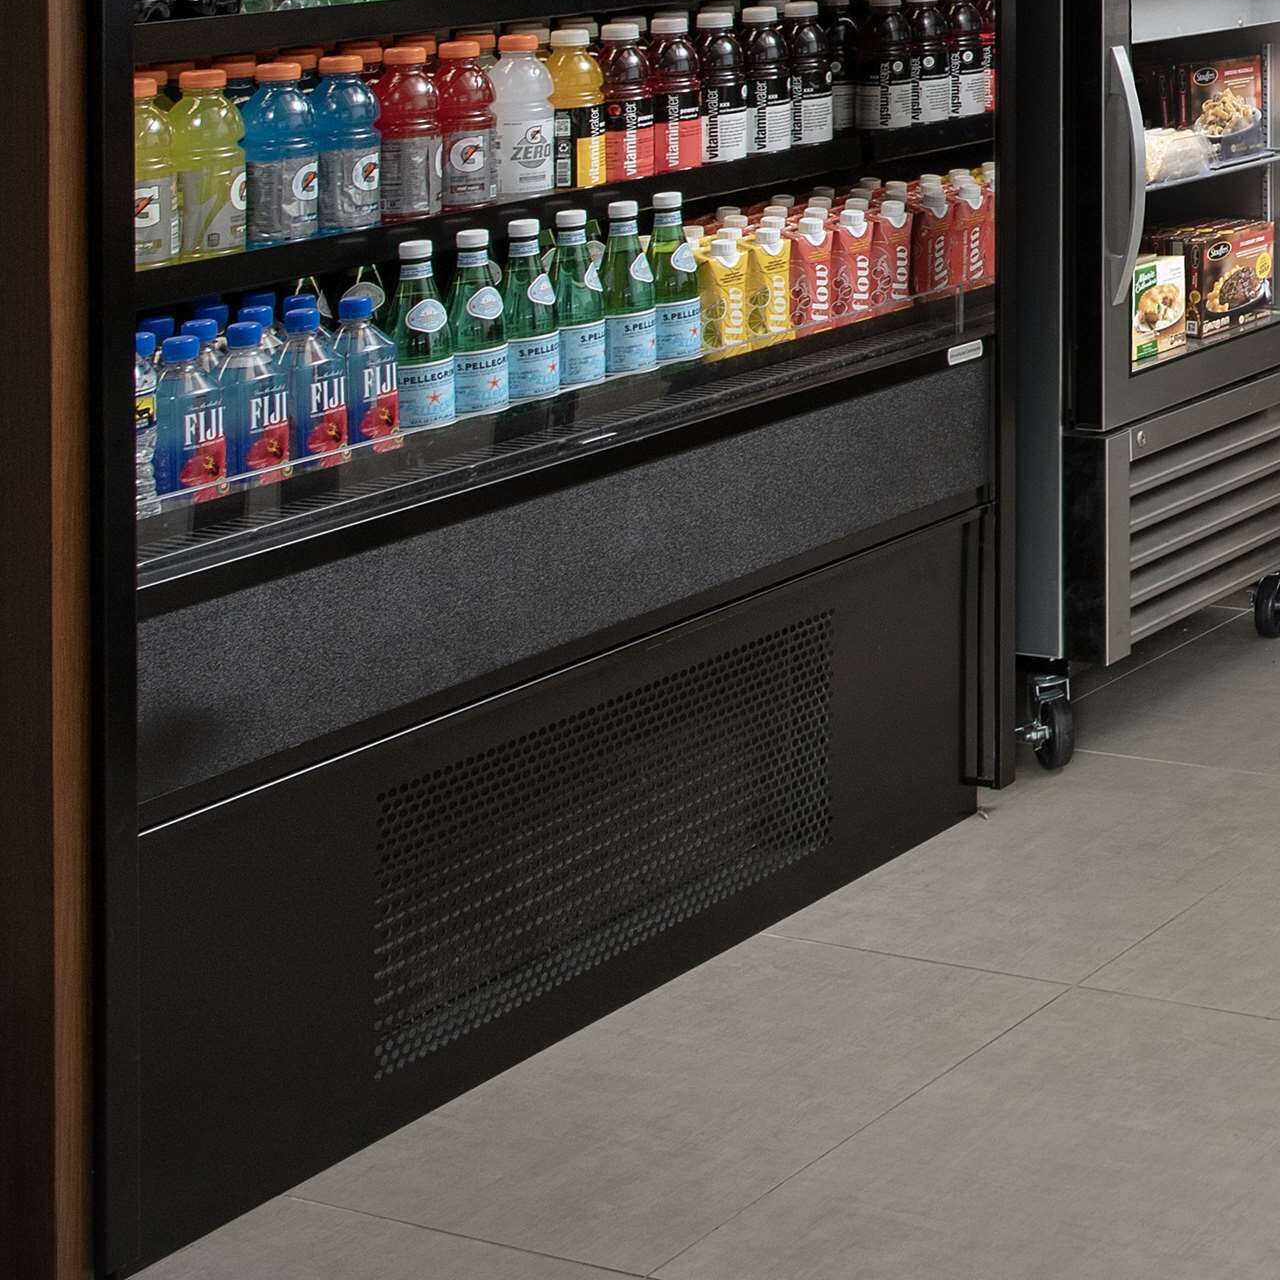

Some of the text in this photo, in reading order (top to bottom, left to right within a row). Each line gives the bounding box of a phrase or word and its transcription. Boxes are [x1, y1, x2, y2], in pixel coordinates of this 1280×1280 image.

[624, 101, 637, 177] vitaminwater
[668, 94, 679, 168] vitaminwater
[709, 87, 720, 161] vitaminwater
[757, 79, 768, 151] vitaminwater
[510, 142, 552, 161] ZERO
[811, 264, 829, 322] flow
[853, 255, 869, 311] flow
[892, 245, 908, 300] flow
[311, 376, 345, 414] FIJI
[363, 362, 398, 399] FIJI
[184, 406, 224, 446] FIJI
[250, 392, 288, 429] FIJI
